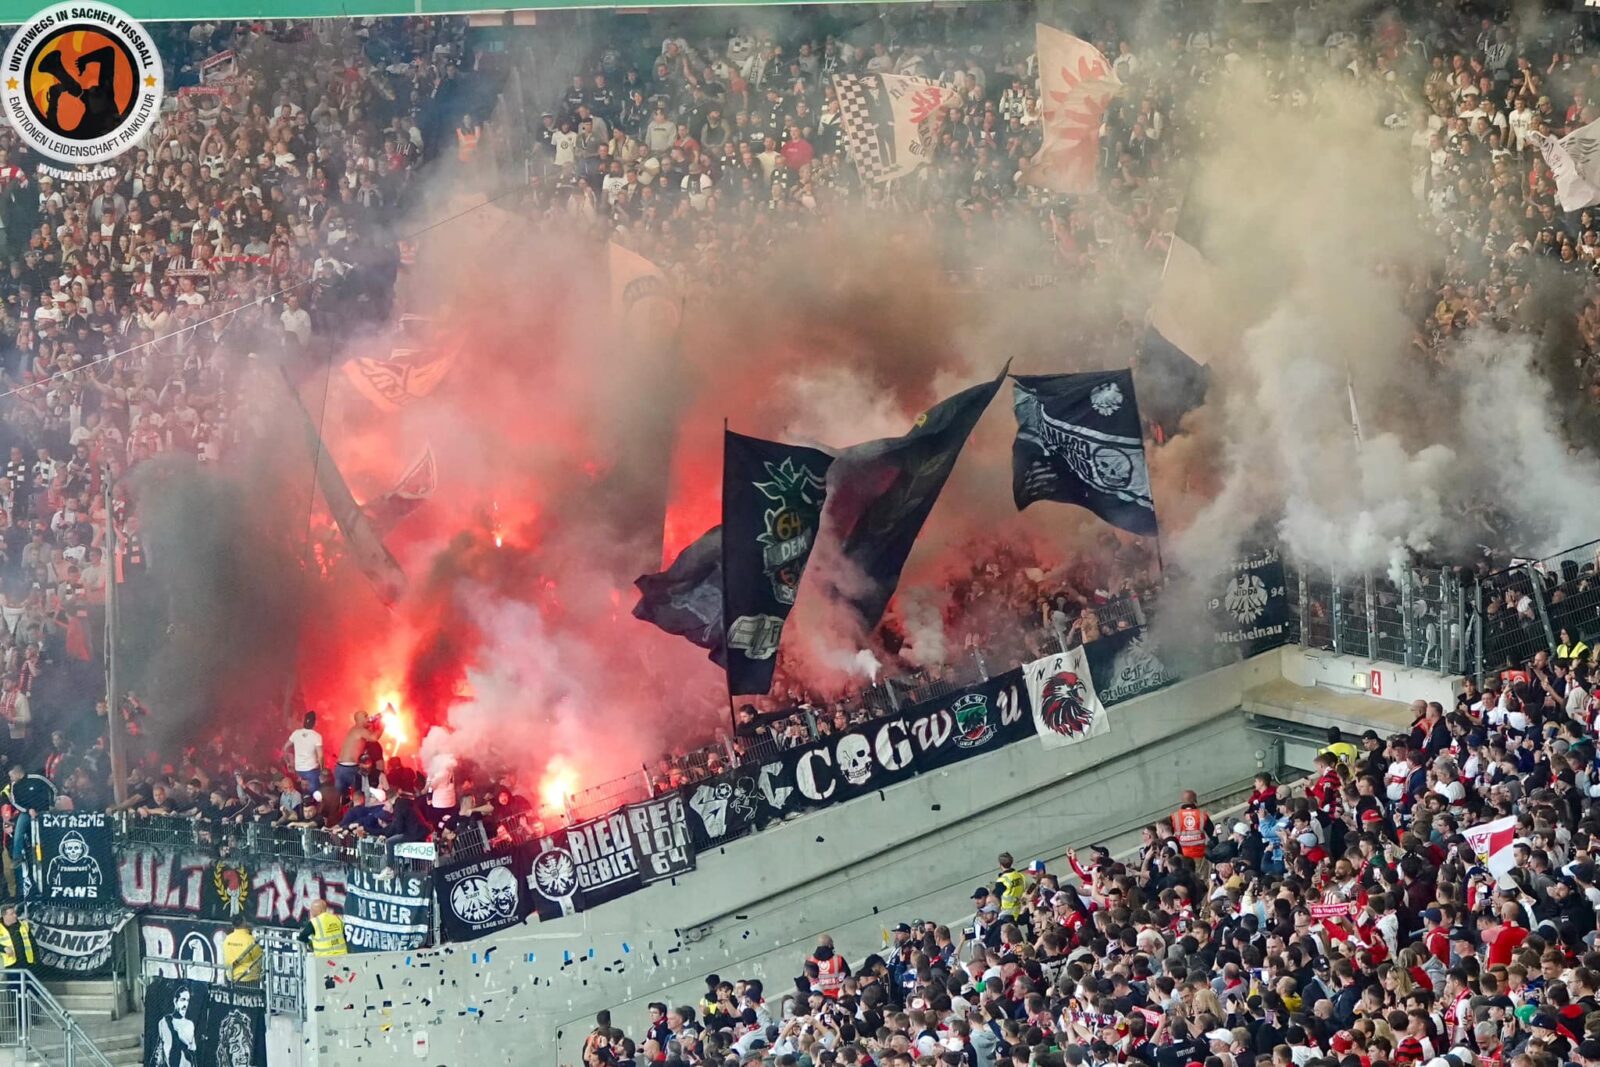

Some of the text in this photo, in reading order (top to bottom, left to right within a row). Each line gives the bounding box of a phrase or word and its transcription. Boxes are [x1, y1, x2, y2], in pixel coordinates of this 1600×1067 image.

[1271, 586, 1285, 597] 94
[1215, 625, 1282, 643] Michelnau
[1372, 672, 1379, 693] 4
[43, 812, 105, 829] EXTREME
[567, 812, 631, 866] RIED
[576, 847, 638, 888] GEBIET
[650, 845, 688, 875] 64
[354, 868, 421, 897] ULTRAS
[445, 864, 479, 881] SEKTOR
[51, 886, 98, 898] FANS
[358, 898, 411, 925] NEVER
[344, 925, 423, 952] SURRENDER
